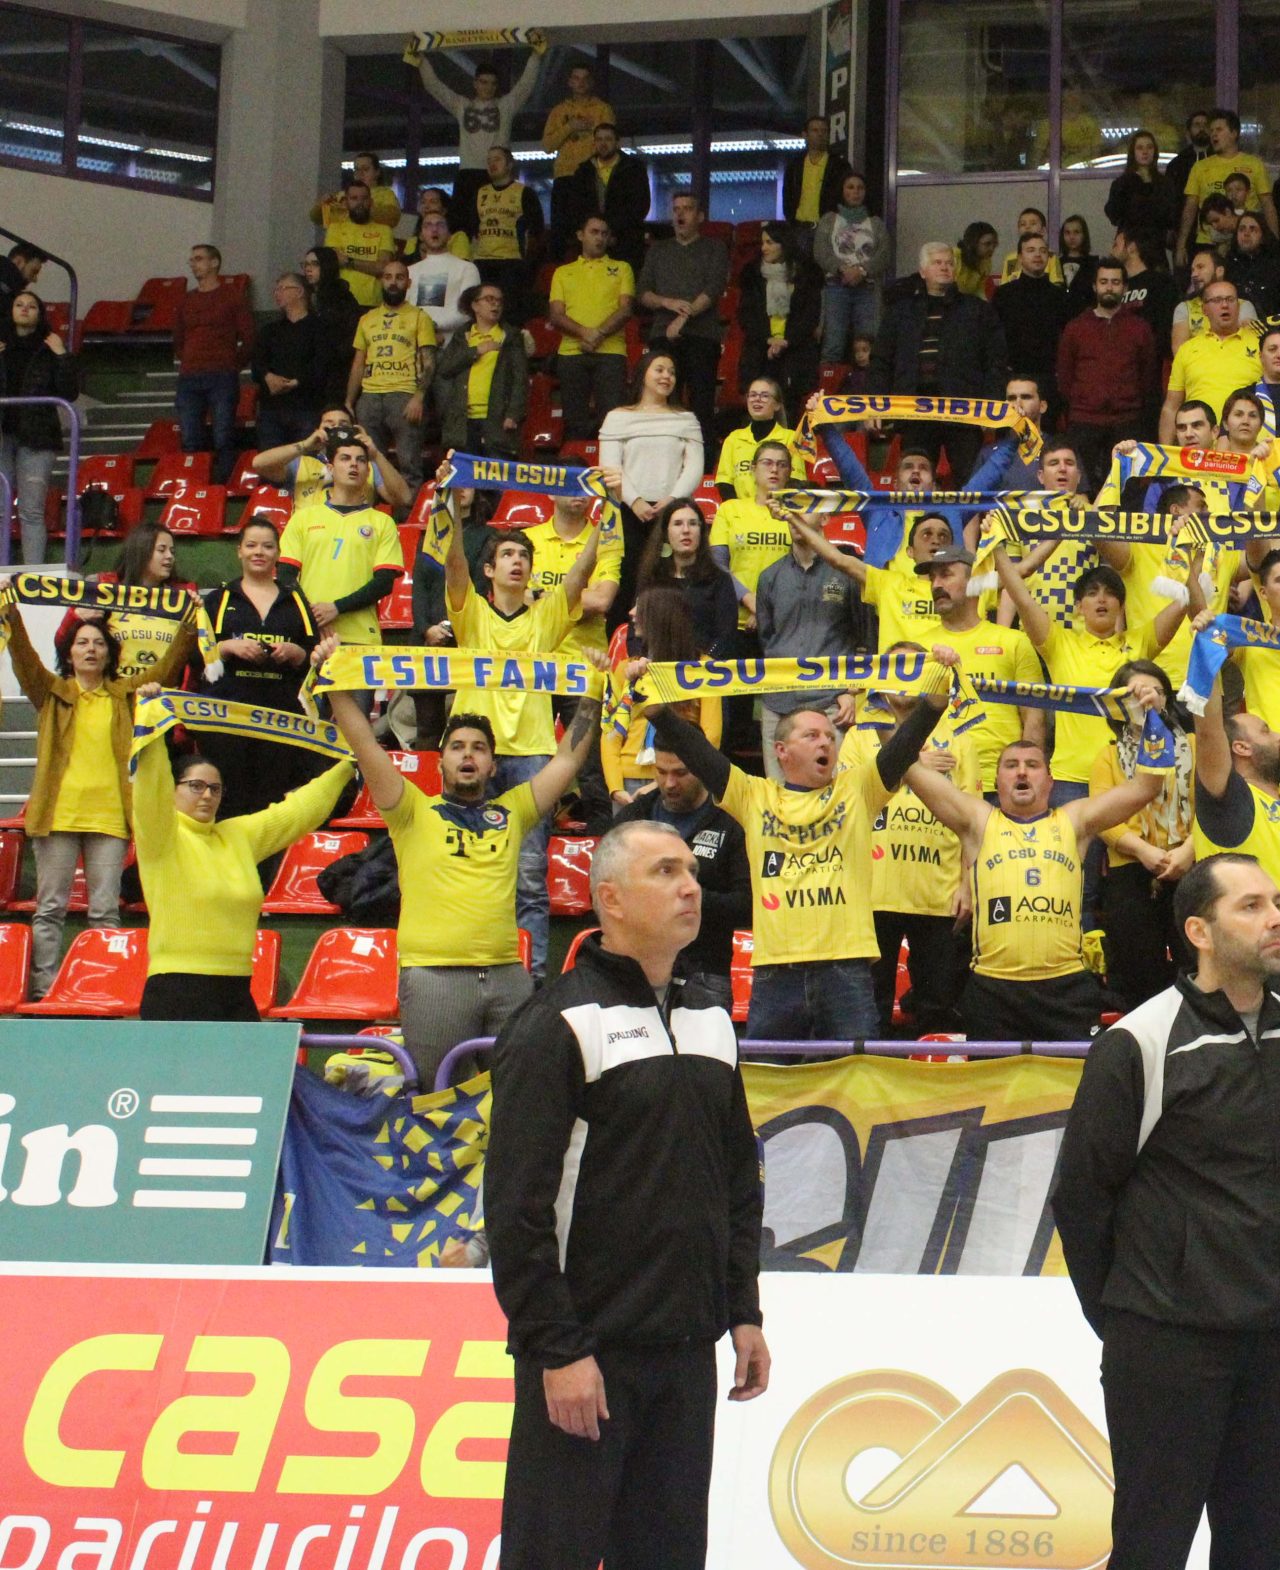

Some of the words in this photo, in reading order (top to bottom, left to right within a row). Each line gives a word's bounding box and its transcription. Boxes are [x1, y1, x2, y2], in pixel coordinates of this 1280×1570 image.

[376, 344, 394, 358] 23
[374, 361, 410, 371] AQUA
[823, 396, 891, 417] CSU
[913, 397, 1009, 421] SIBIU
[472, 461, 510, 481] HAI
[515, 463, 568, 487] CSU!
[1204, 460, 1238, 471] pariurilor
[1016, 508, 1086, 533] CSU
[1207, 510, 1278, 536] CSU
[333, 538, 345, 561] 7
[746, 531, 792, 547] SIBIU
[18, 573, 85, 601] CSU
[96, 582, 187, 613] SIBIU
[132, 629, 153, 640] CSU
[154, 631, 174, 644] SIB
[362, 655, 450, 687] CSU
[473, 656, 587, 694] FANS
[674, 658, 766, 690] CSU
[796, 653, 926, 685] SIBIU
[183, 700, 228, 718] CSU
[250, 709, 316, 735] SIBIU
[890, 823, 946, 837] CARPATICA
[785, 845, 844, 869] AQUA
[891, 843, 941, 866] VISMA
[985, 853, 1002, 871] BC
[1043, 849, 1075, 873] SIBIU
[1025, 868, 1041, 887] 6
[785, 886, 846, 908] VISMA
[1015, 896, 1074, 919] AQUA
[1014, 914, 1074, 929] CARPATICA
[23, 1333, 515, 1500] casa
[0, 1501, 503, 1570] pariurilo
[851, 1524, 947, 1555] since
[965, 1529, 1054, 1558] 1886
